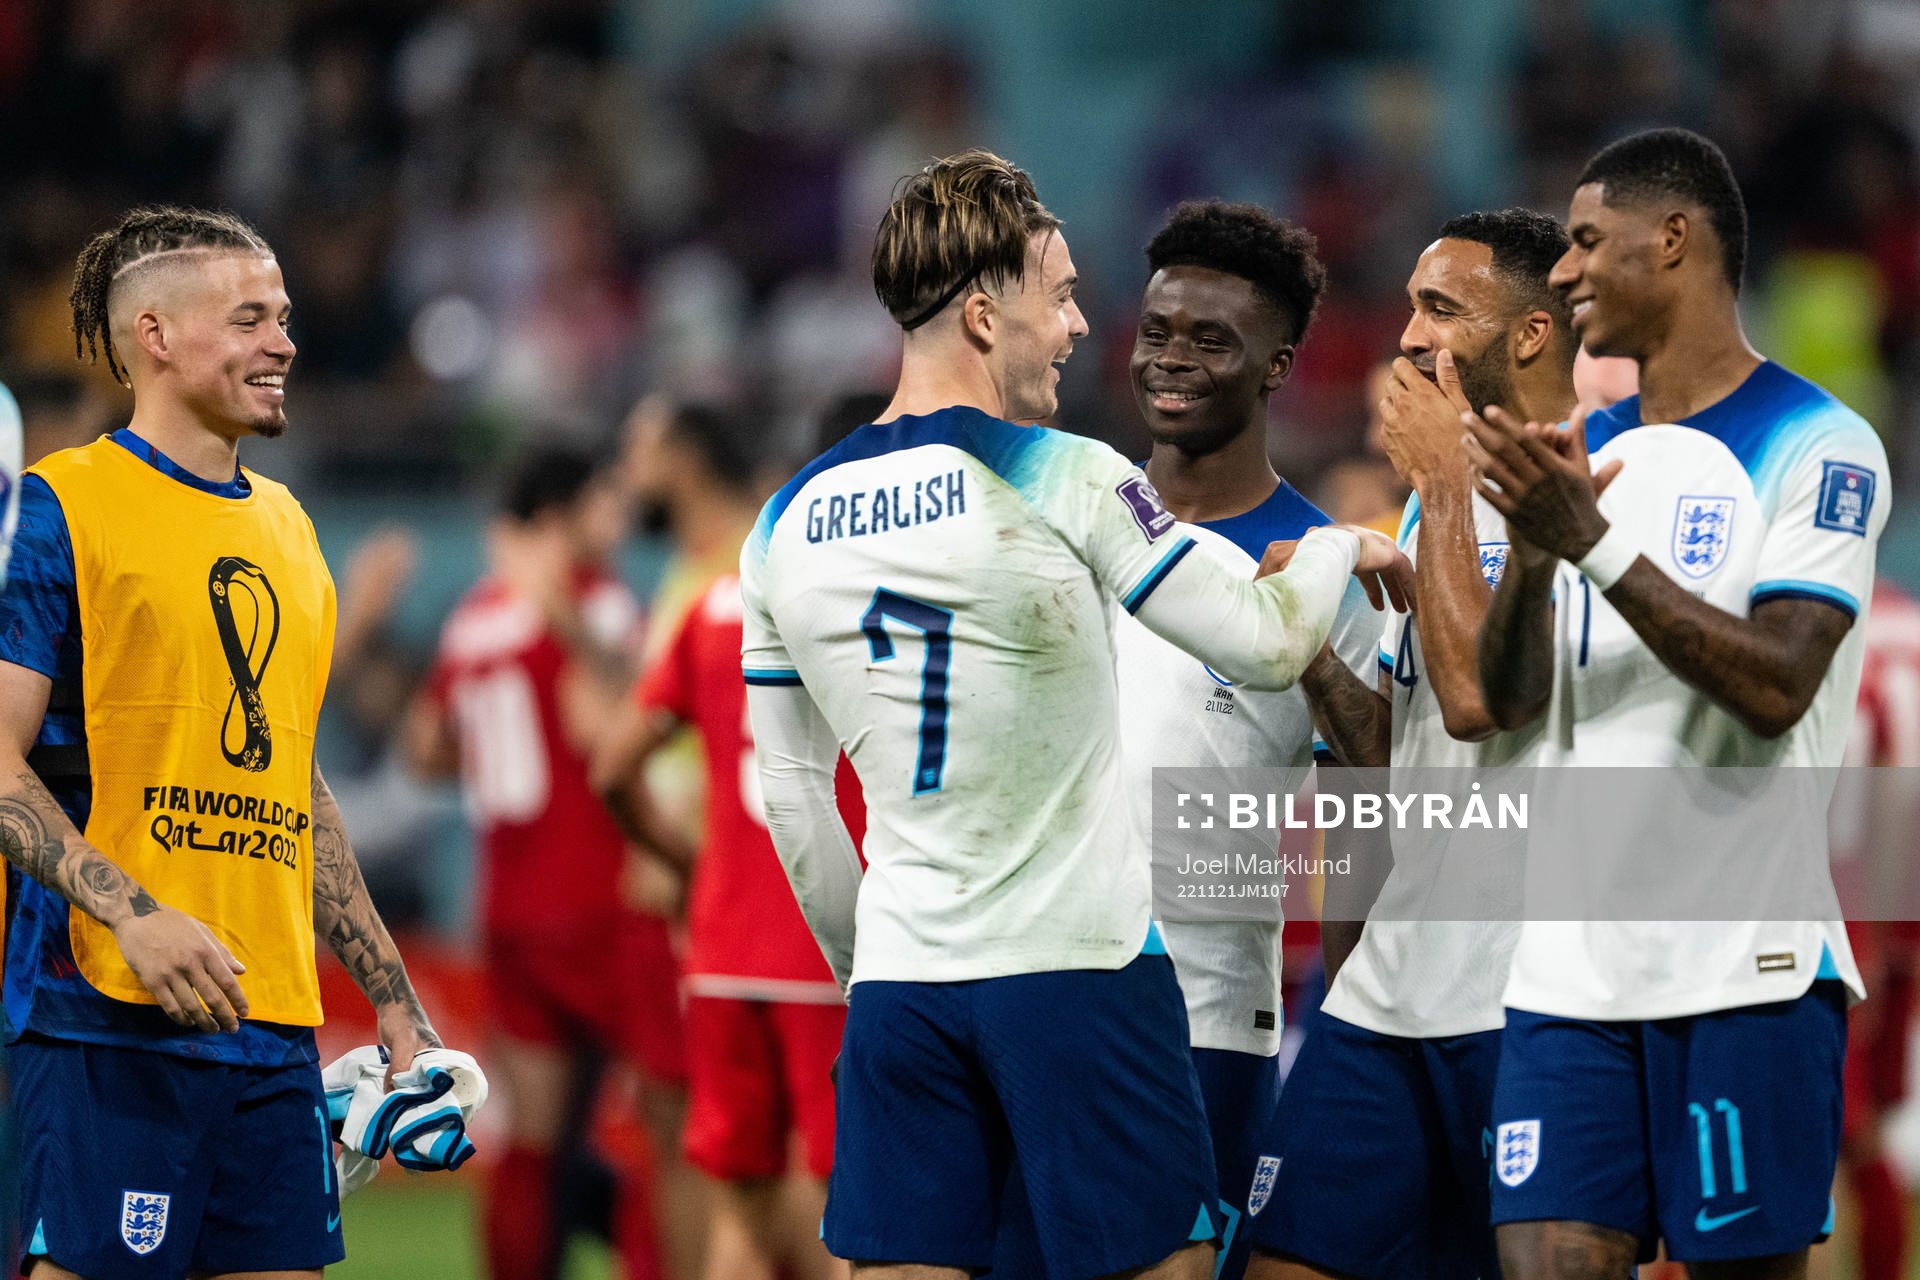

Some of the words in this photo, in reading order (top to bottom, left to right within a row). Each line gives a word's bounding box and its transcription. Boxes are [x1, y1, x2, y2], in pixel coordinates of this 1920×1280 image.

[807, 469, 965, 544] GREALISH
[859, 585, 954, 797] 7
[143, 785, 190, 813] FIFA
[194, 789, 284, 827] WORLD
[284, 807, 309, 837] CUP
[1688, 1098, 1747, 1199] 11
